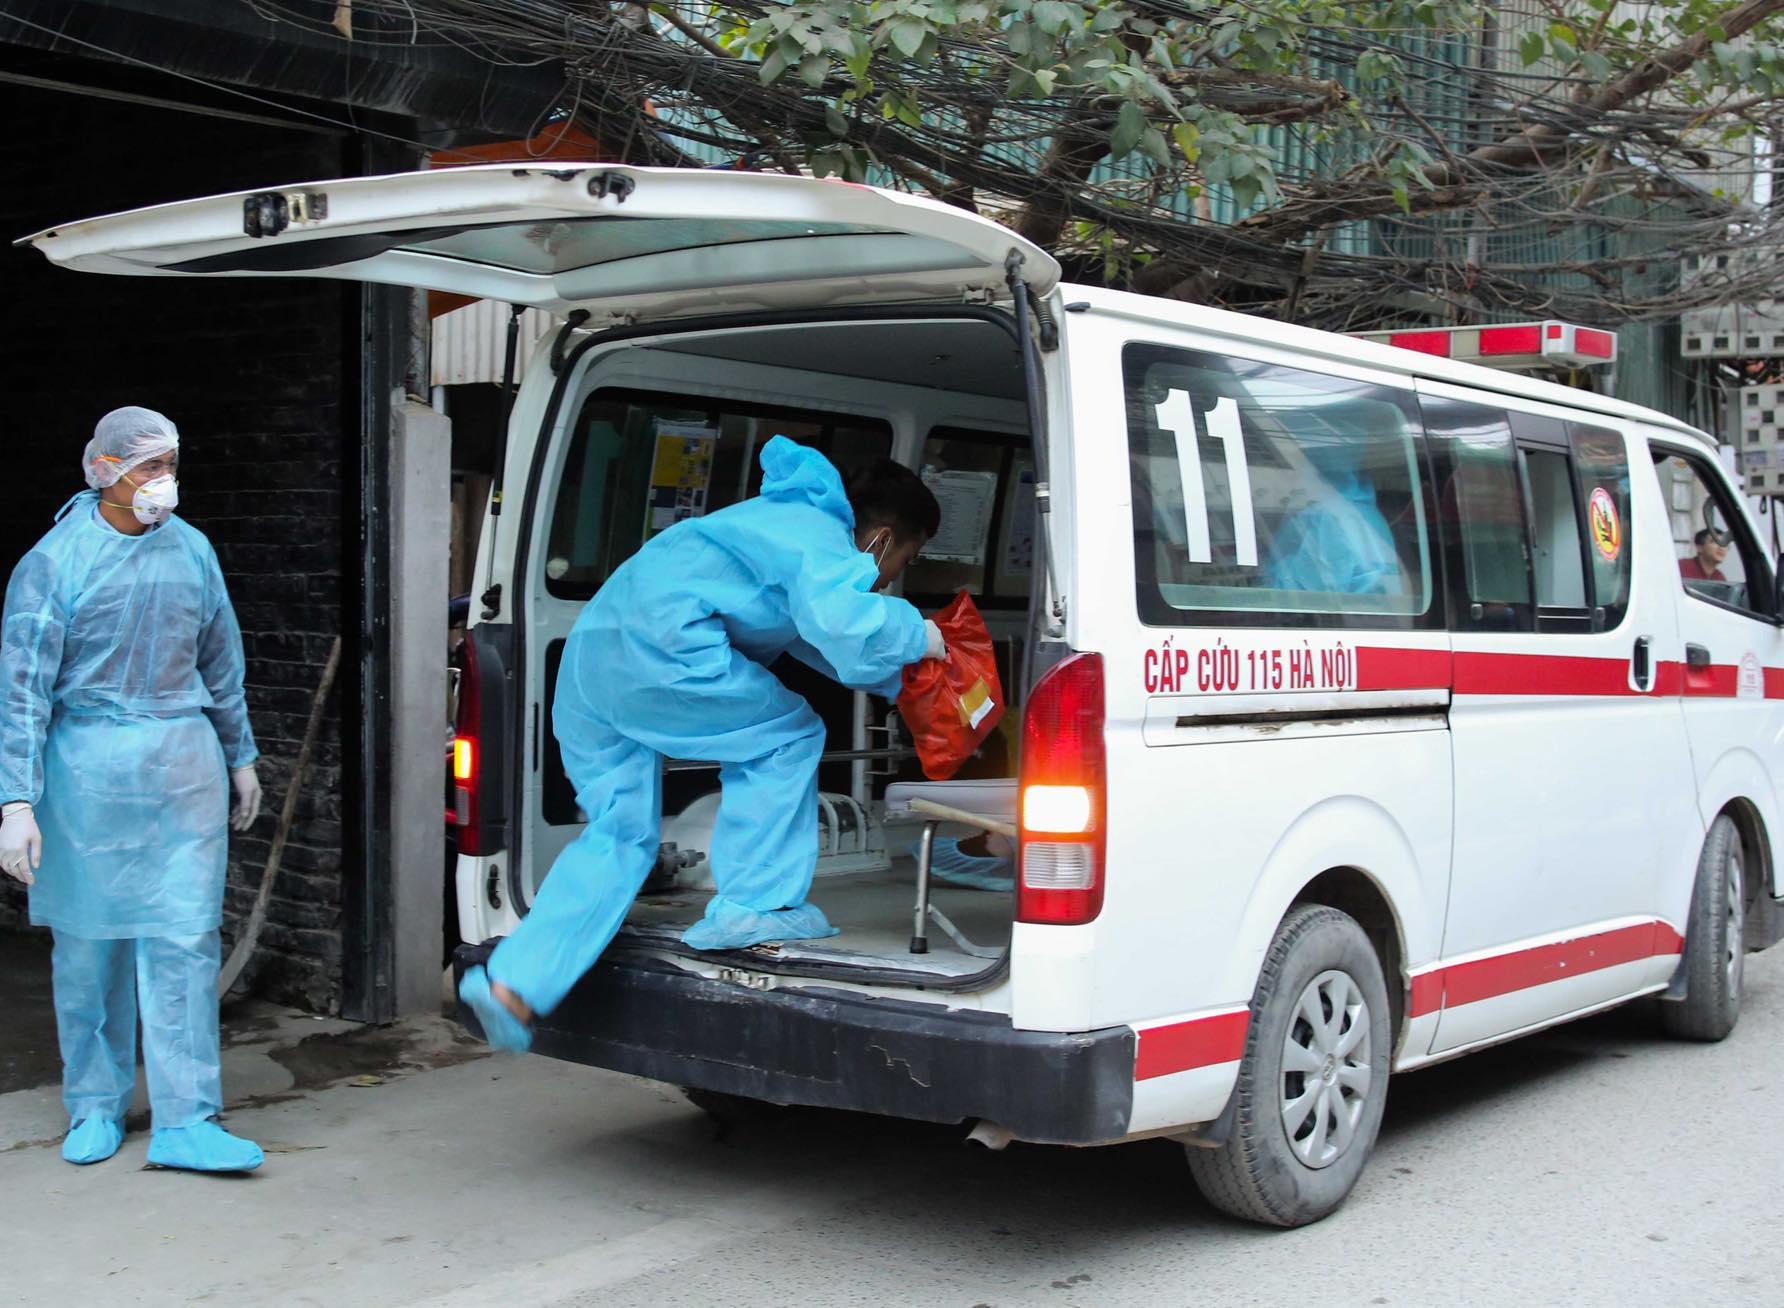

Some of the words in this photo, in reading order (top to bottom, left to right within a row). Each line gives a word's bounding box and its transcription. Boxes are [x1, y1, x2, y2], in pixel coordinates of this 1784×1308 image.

[1154, 388, 1259, 567] 11
[1144, 635, 1189, 693] CẤP
[1198, 637, 1239, 691] CỨU
[1248, 649, 1282, 690] 115
[1290, 640, 1315, 689] HÀ
[1321, 641, 1352, 692] NỘI
